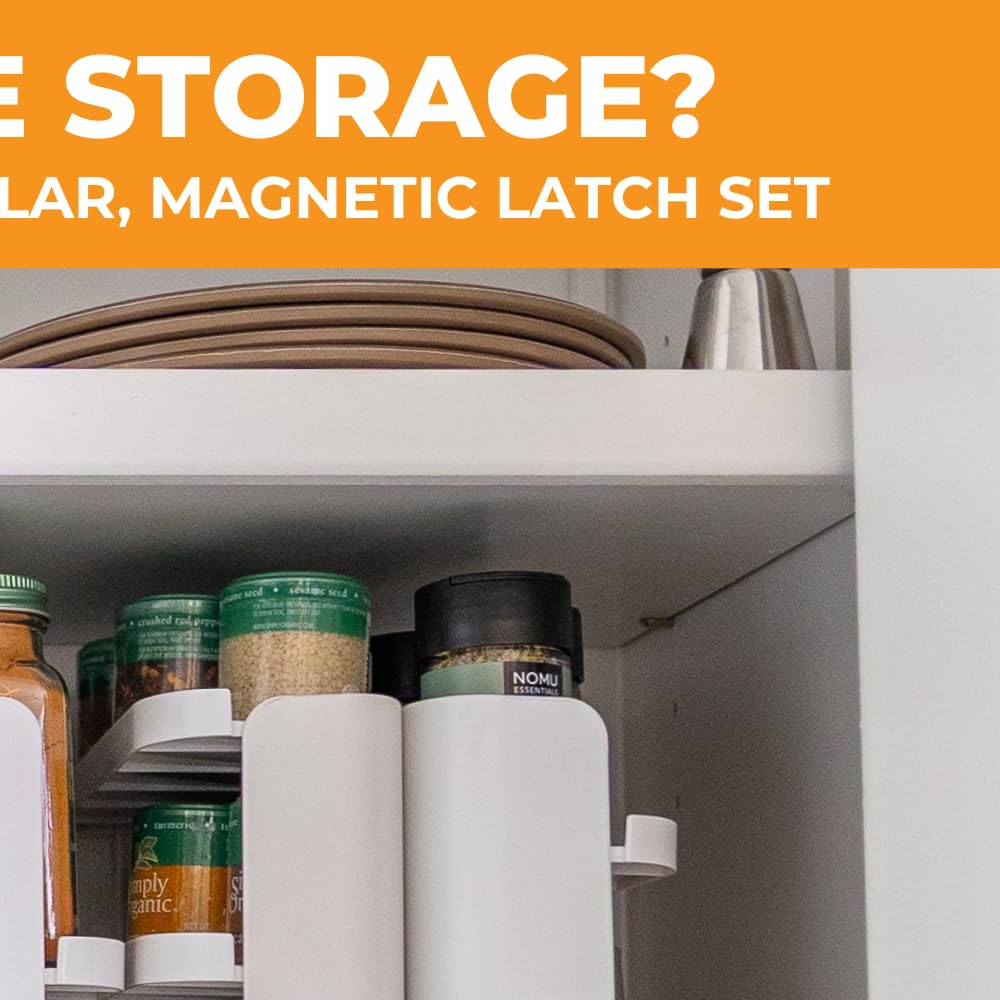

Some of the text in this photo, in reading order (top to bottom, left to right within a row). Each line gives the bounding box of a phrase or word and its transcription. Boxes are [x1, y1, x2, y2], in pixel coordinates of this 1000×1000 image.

[244, 587, 264, 598] seed
[289, 587, 348, 598] sesame seed
[174, 615, 192, 626] red
[193, 618, 219, 629] pepp
[512, 671, 559, 688] NOMU
[513, 686, 559, 696] ESSENTIALS
